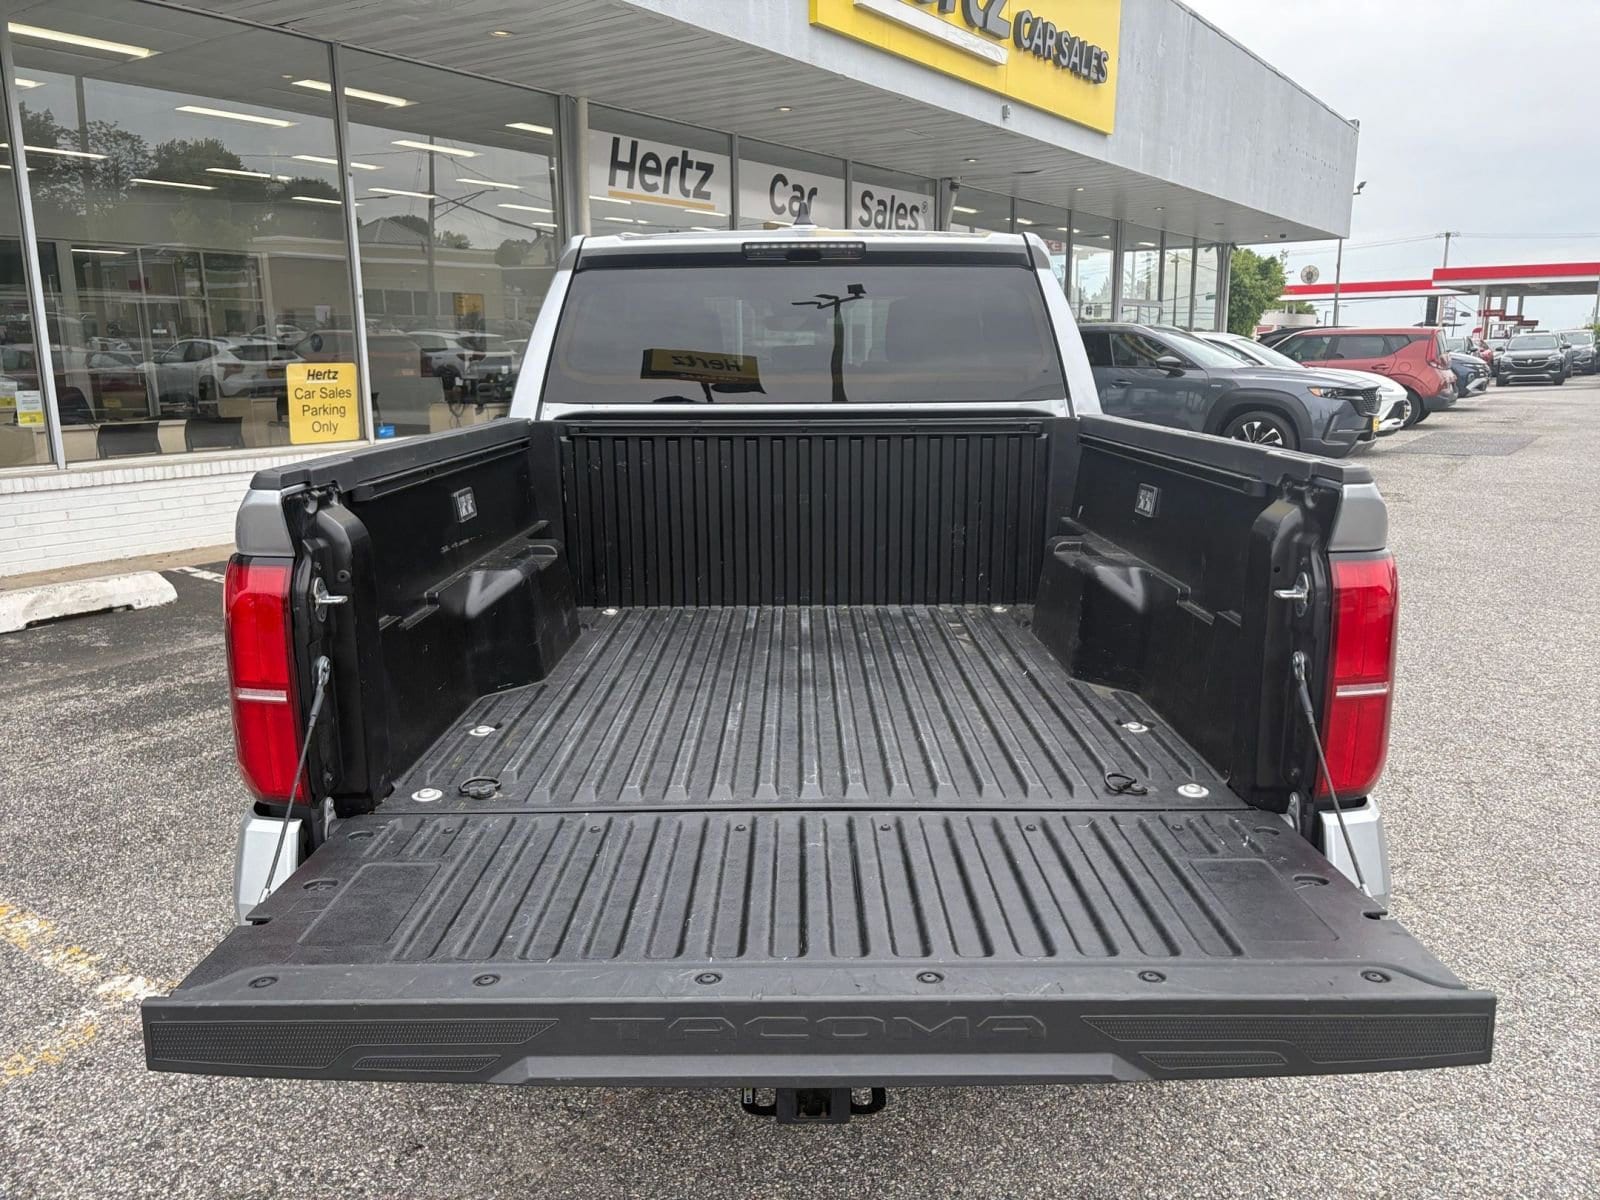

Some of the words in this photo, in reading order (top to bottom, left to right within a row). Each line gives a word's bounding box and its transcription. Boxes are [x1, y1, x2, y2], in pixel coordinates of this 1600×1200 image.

[1014, 9, 1057, 60] CAR
[1056, 31, 1109, 84] SALES
[608, 137, 714, 200] Hertz
[769, 173, 818, 220] Car
[307, 369, 339, 381] Hertz
[294, 387, 316, 400] Car
[319, 387, 352, 399] Sales
[302, 404, 346, 417] Parking
[312, 421, 339, 434] Only
[590, 1016, 1047, 1040] TACOMA
